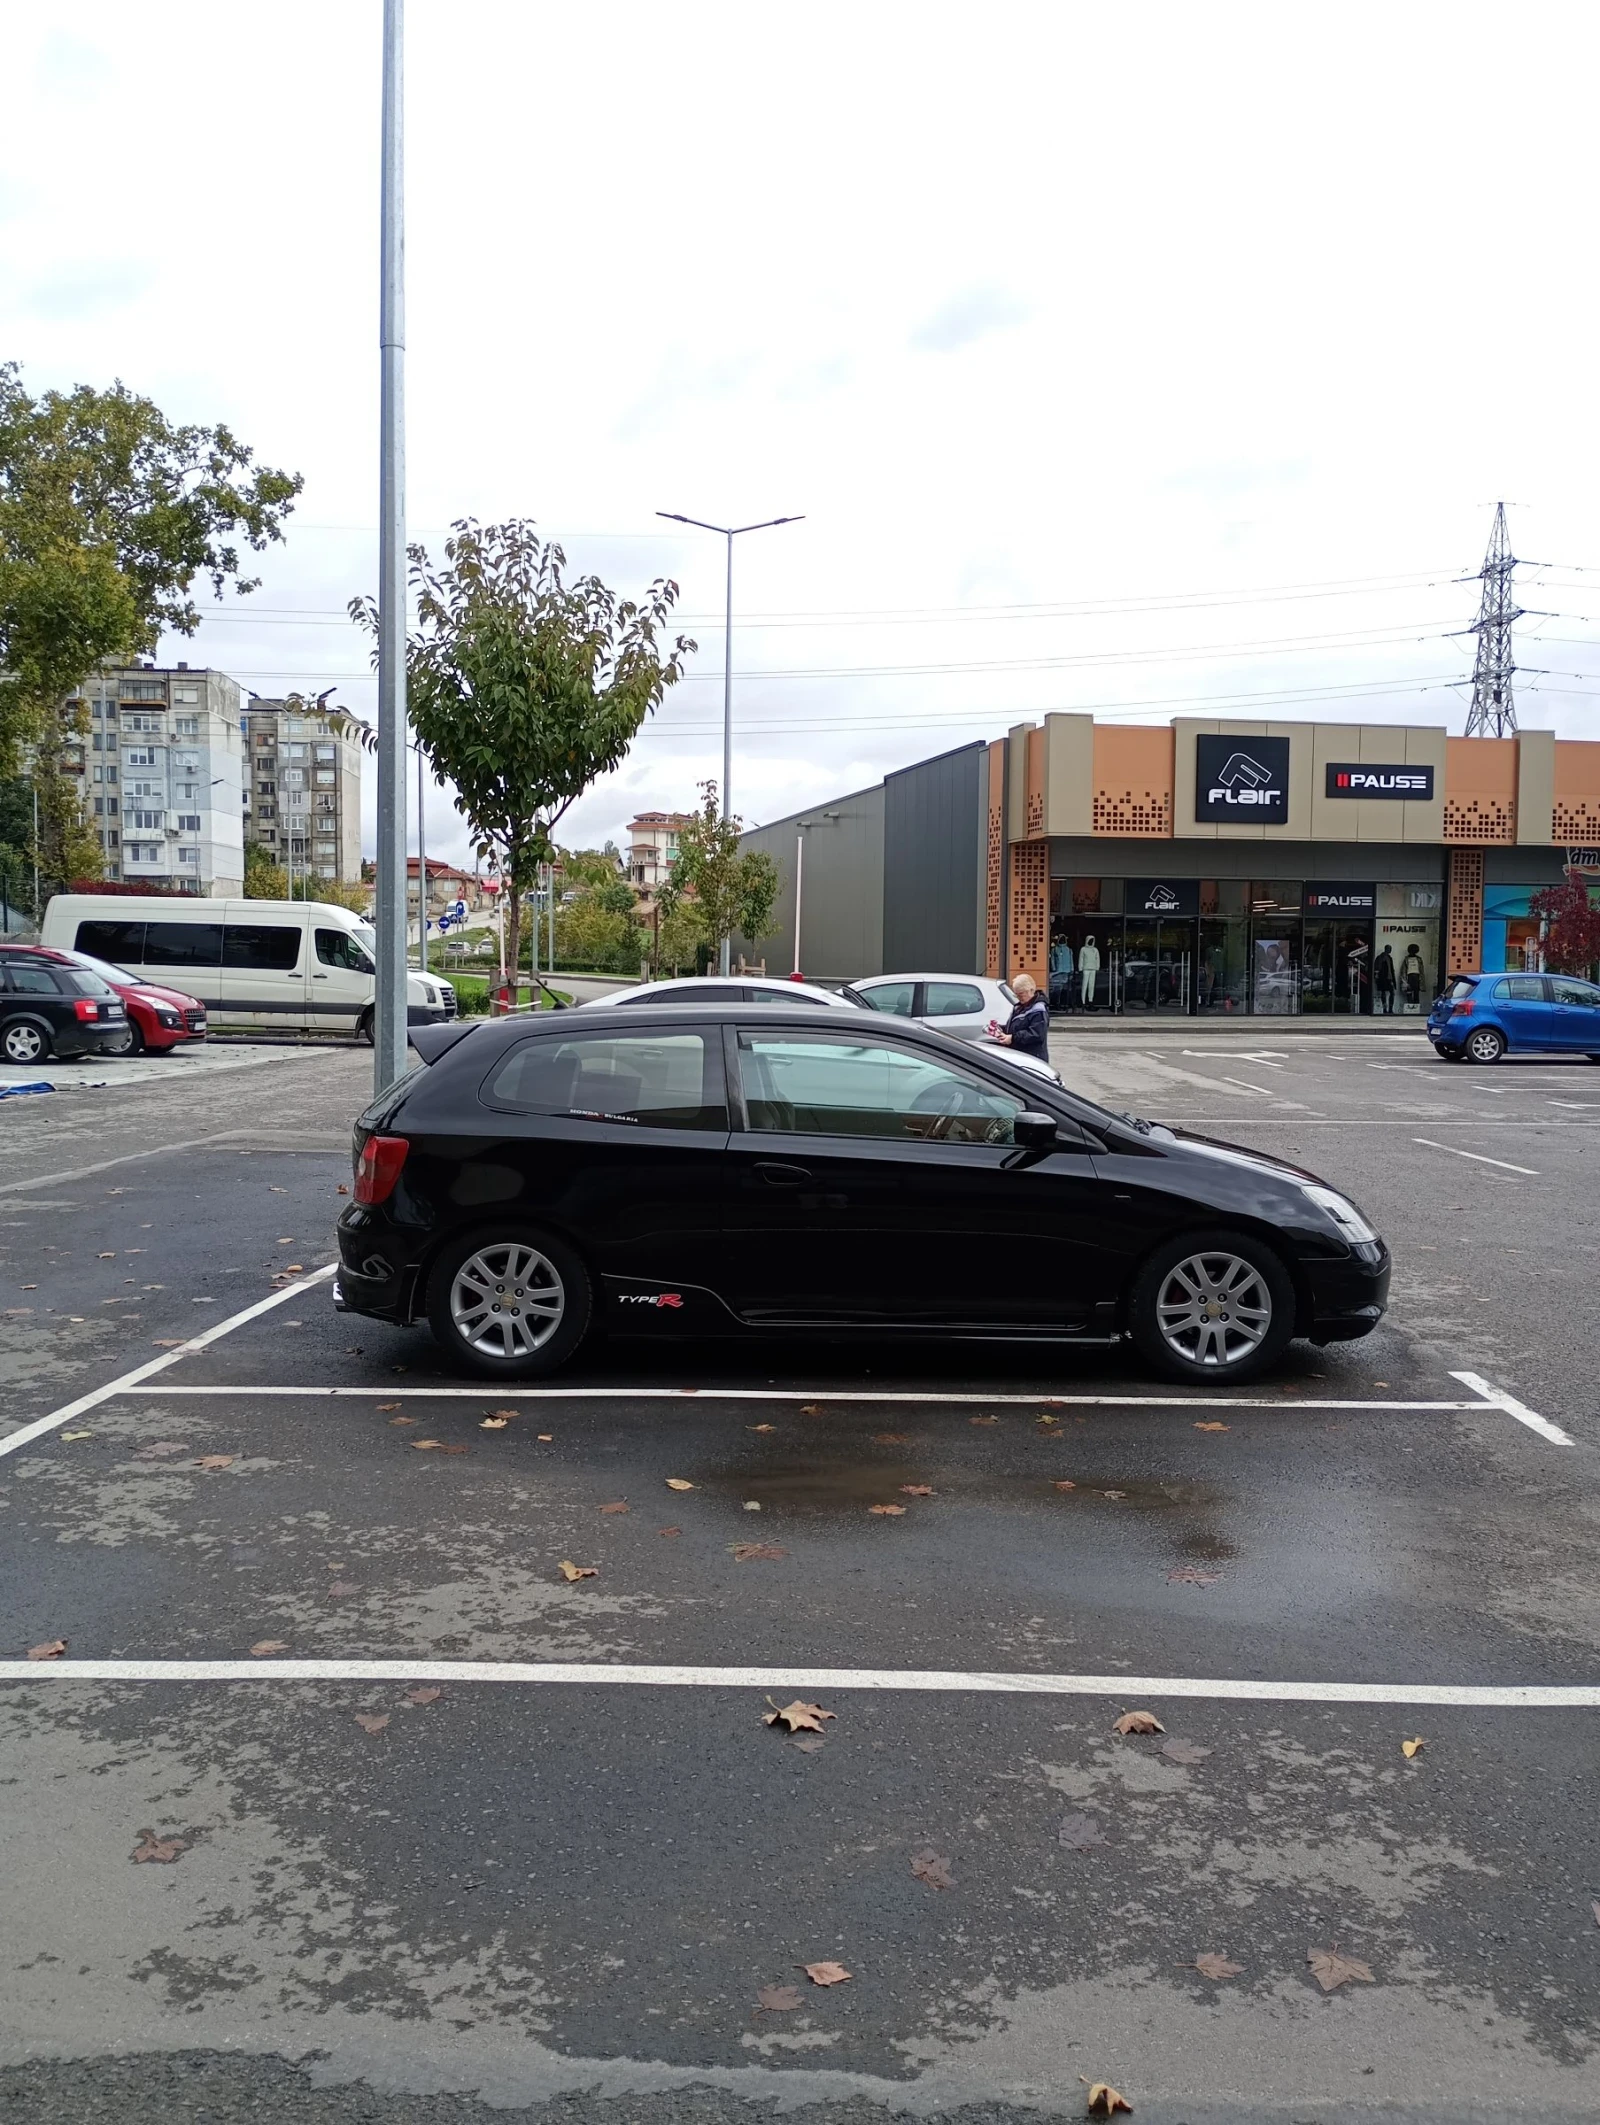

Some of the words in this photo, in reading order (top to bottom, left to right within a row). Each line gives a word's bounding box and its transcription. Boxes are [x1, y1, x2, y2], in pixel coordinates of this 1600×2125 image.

[1350, 774, 1427, 789] PAUSE
[1318, 895, 1373, 906] PAUSE
[1390, 925, 1427, 933] PAUSE
[569, 1109, 599, 1117] HONDA
[604, 1113, 639, 1123] BULGARIA
